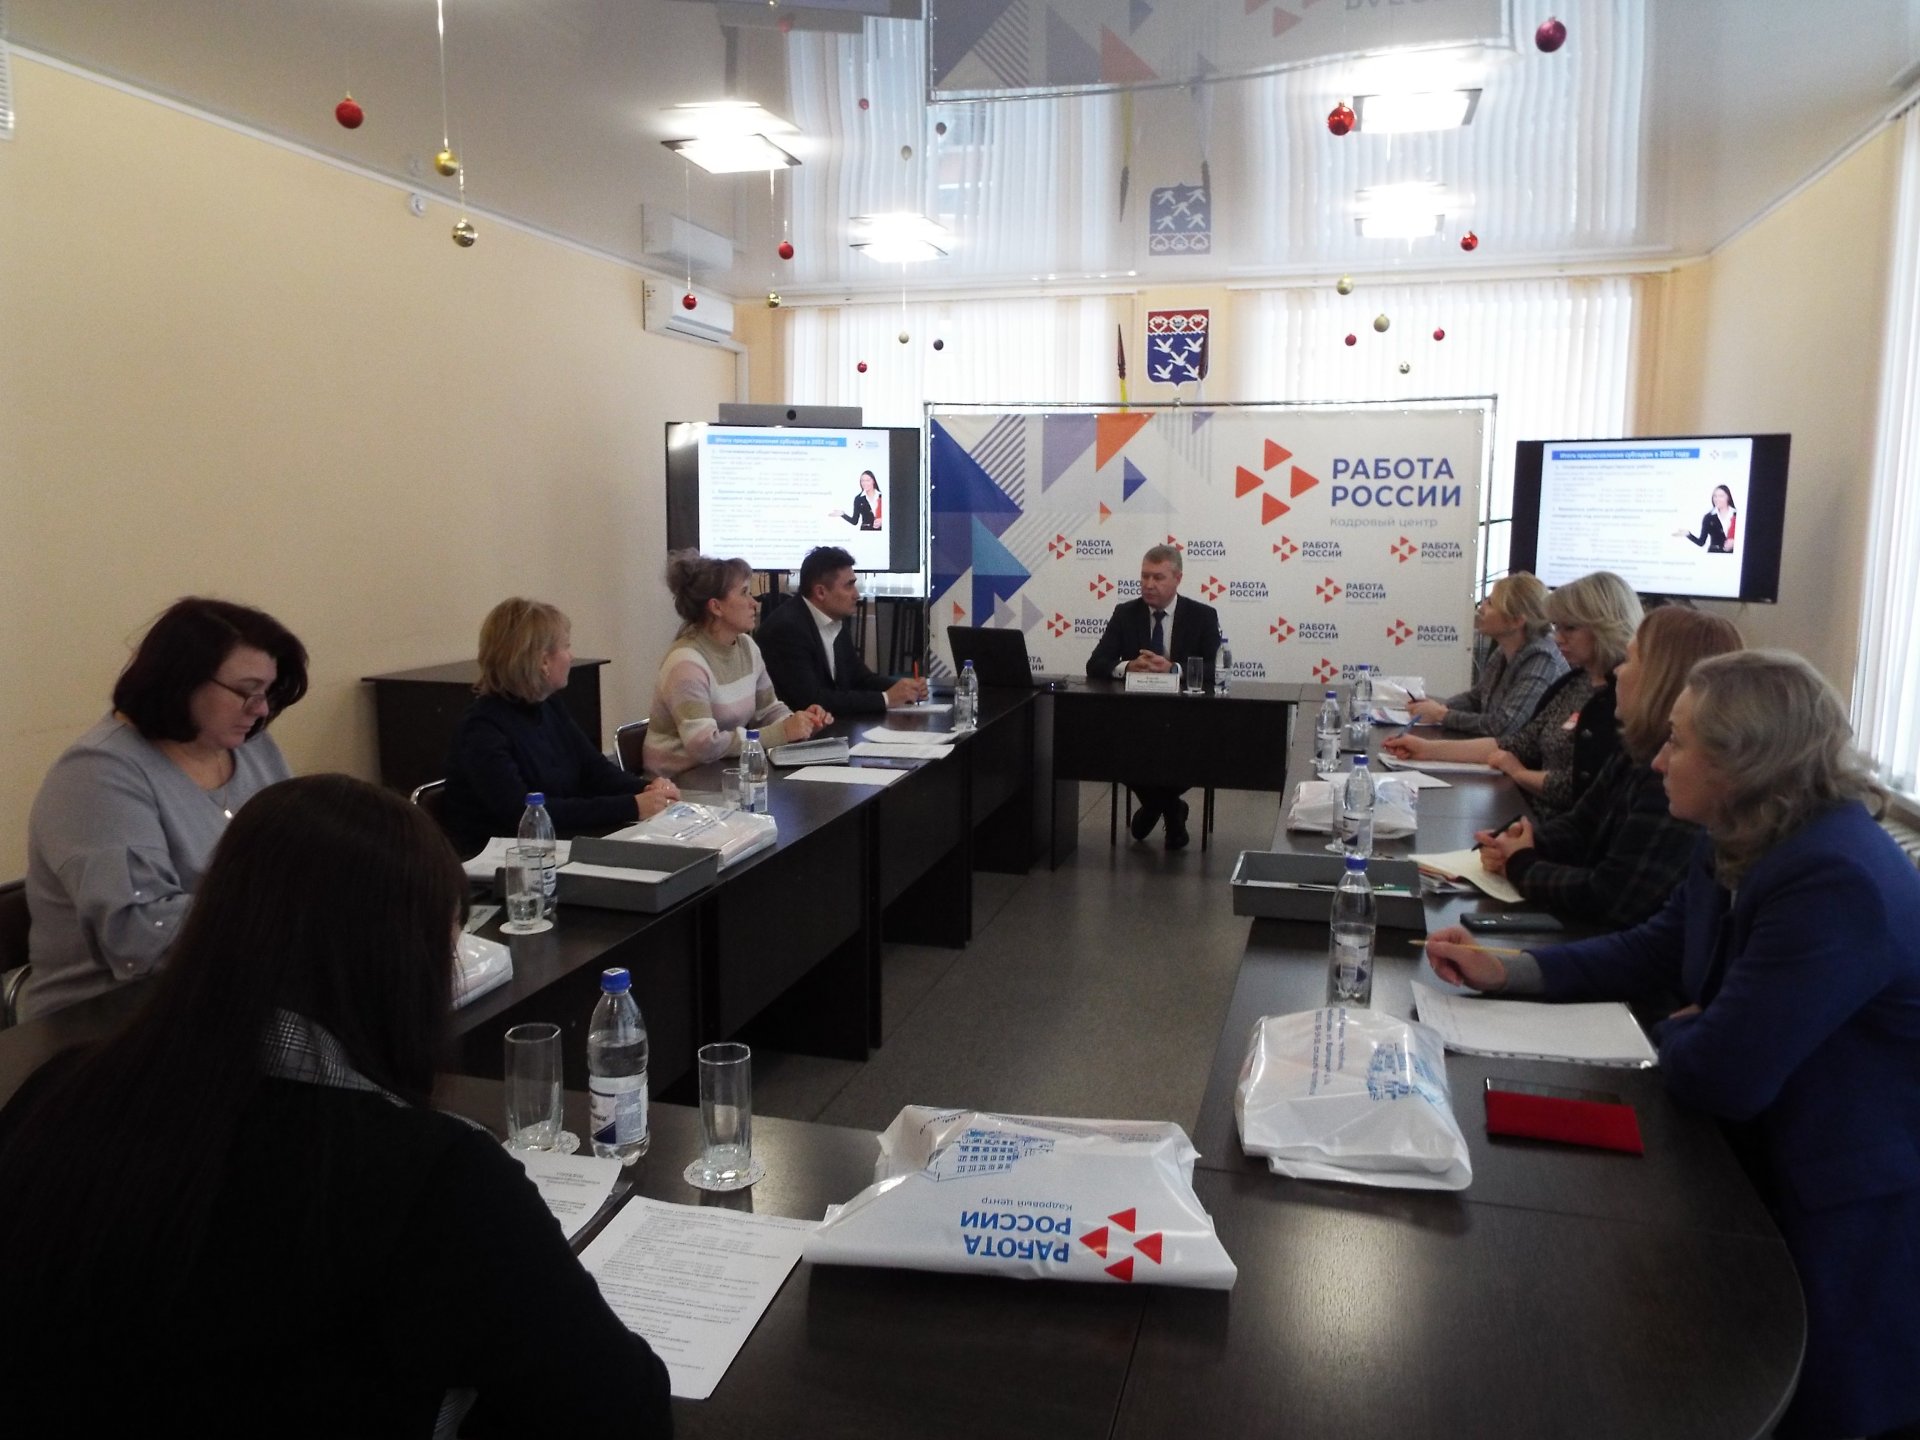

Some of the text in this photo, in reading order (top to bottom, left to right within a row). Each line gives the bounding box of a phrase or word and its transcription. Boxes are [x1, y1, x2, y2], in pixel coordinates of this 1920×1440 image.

[1332, 458, 1455, 480] РАБОТА
[1331, 485, 1461, 507] РОССИИ
[1330, 517, 1438, 528] Кадровый центр
[1076, 539, 1111, 547] РАБОТА
[1302, 541, 1340, 549] РАБОТА
[1421, 542, 1460, 550] РАБОТА
[1421, 551, 1462, 559] РОССИИ
[1118, 580, 1141, 588] РАБО
[1230, 582, 1266, 590] РАБОТА
[1346, 583, 1384, 591] РАБОТА
[1230, 590, 1268, 598] РОССИИ
[1346, 591, 1386, 599] РОССИИ
[1299, 623, 1336, 631] РАБОТА
[1417, 625, 1456, 633] РАБОТА
[1417, 634, 1458, 642] РОССИИ
[1232, 670, 1266, 678] ОССИИ
[981, 1196, 1073, 1211] Кадровый центр
[961, 1211, 1071, 1235] РОССИИ
[963, 1234, 1069, 1263] РАБОТА
